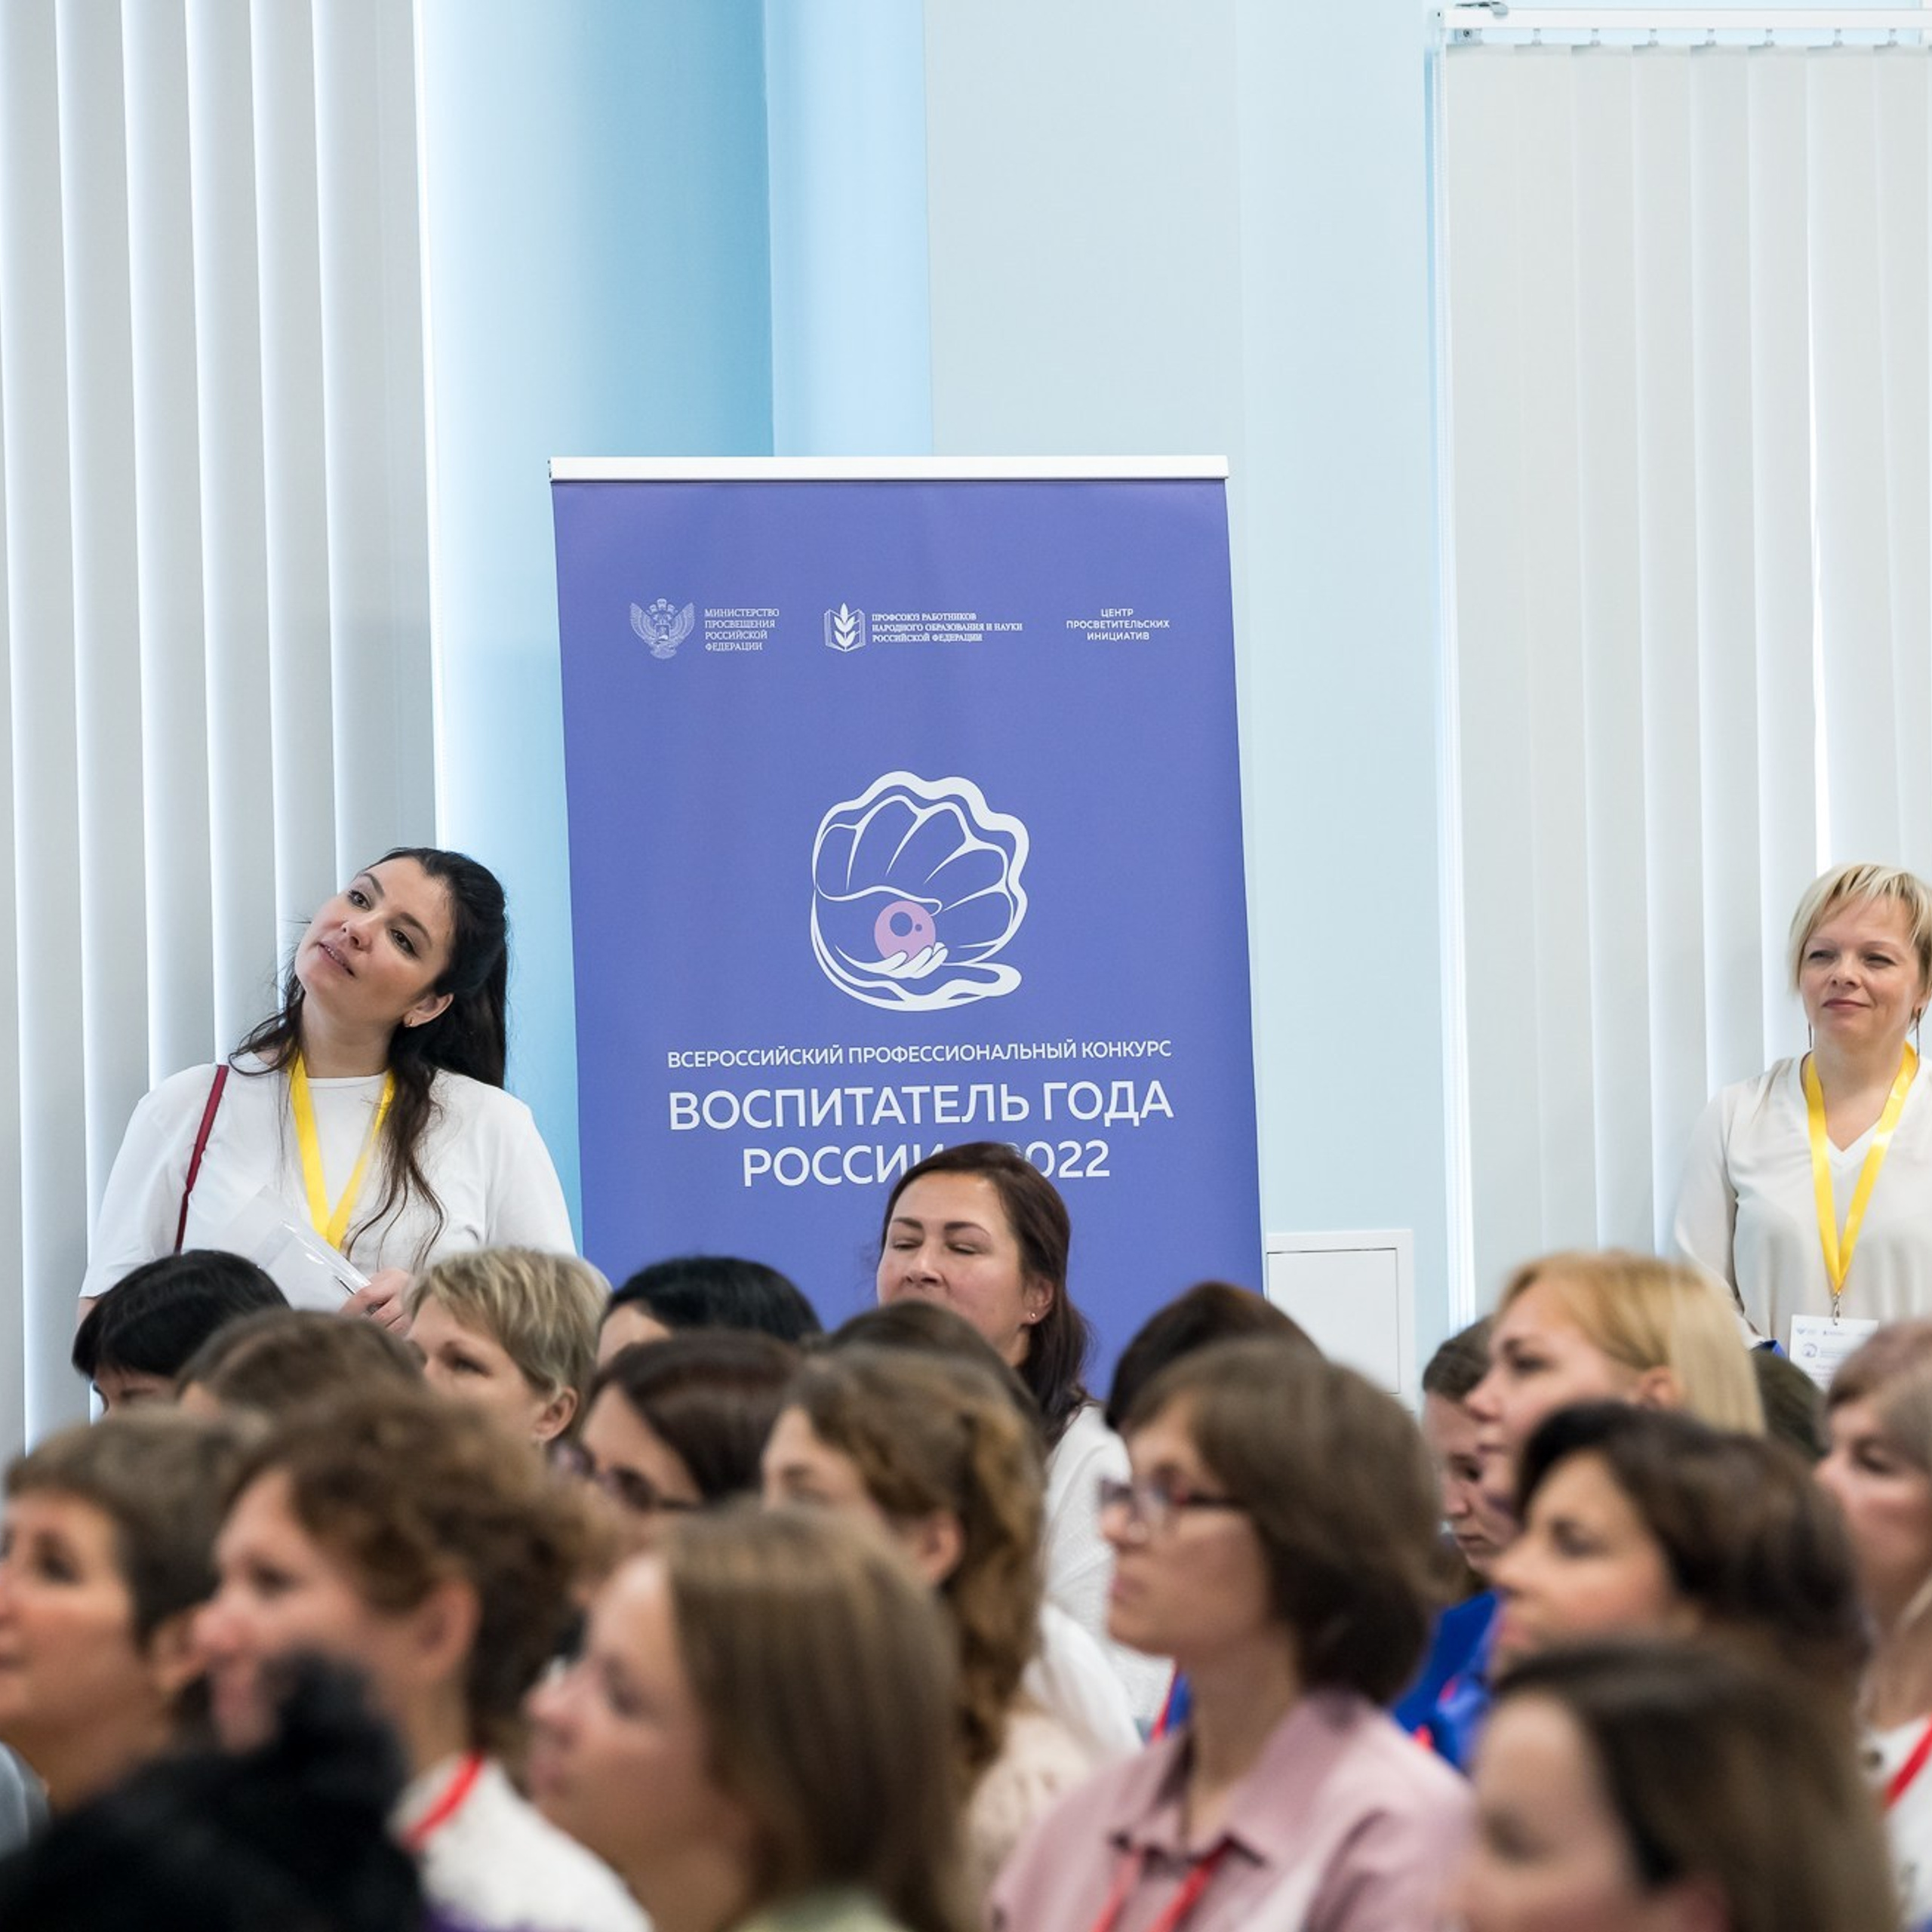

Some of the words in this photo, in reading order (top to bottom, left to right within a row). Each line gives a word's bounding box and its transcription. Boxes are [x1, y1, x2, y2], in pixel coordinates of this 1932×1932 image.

[704, 608, 780, 617] МИНИСТЕРСТВО
[921, 613, 977, 621] РАБОТНИКОВ
[1100, 608, 1134, 618] ЦЕНТР
[705, 620, 776, 629] ПРОСВЕЩЕНИЯ
[872, 624, 924, 633] НАРОДНОГО
[924, 623, 984, 632] ОБРАЗОВАНИЯ
[986, 623, 993, 632] И
[994, 623, 1023, 632] НАУКИ
[1066, 620, 1171, 629] ПРОСВЕТИТЕЛЬСКИХ
[705, 629, 768, 640] РОССИЙСКОЙ
[872, 632, 931, 643] РОССИЙСКОЙ
[931, 633, 983, 643] ФЕДЕРАЦИИ
[1087, 632, 1150, 641] ИНИЦИАТИВ
[705, 641, 763, 652] ФЕДЕРАЦИИ
[668, 1044, 844, 1068] ВСЕРОССИЙСКИЙ
[848, 1038, 1077, 1064] ПРОФЕССИОНАЛЬНЫЙ
[1081, 1040, 1172, 1059] КОНКУРС
[669, 1083, 1030, 1131] ВОСПИТАТЕЛЬ
[1043, 1080, 1174, 1128] ГОДА
[1006, 1139, 1110, 1179] 022
